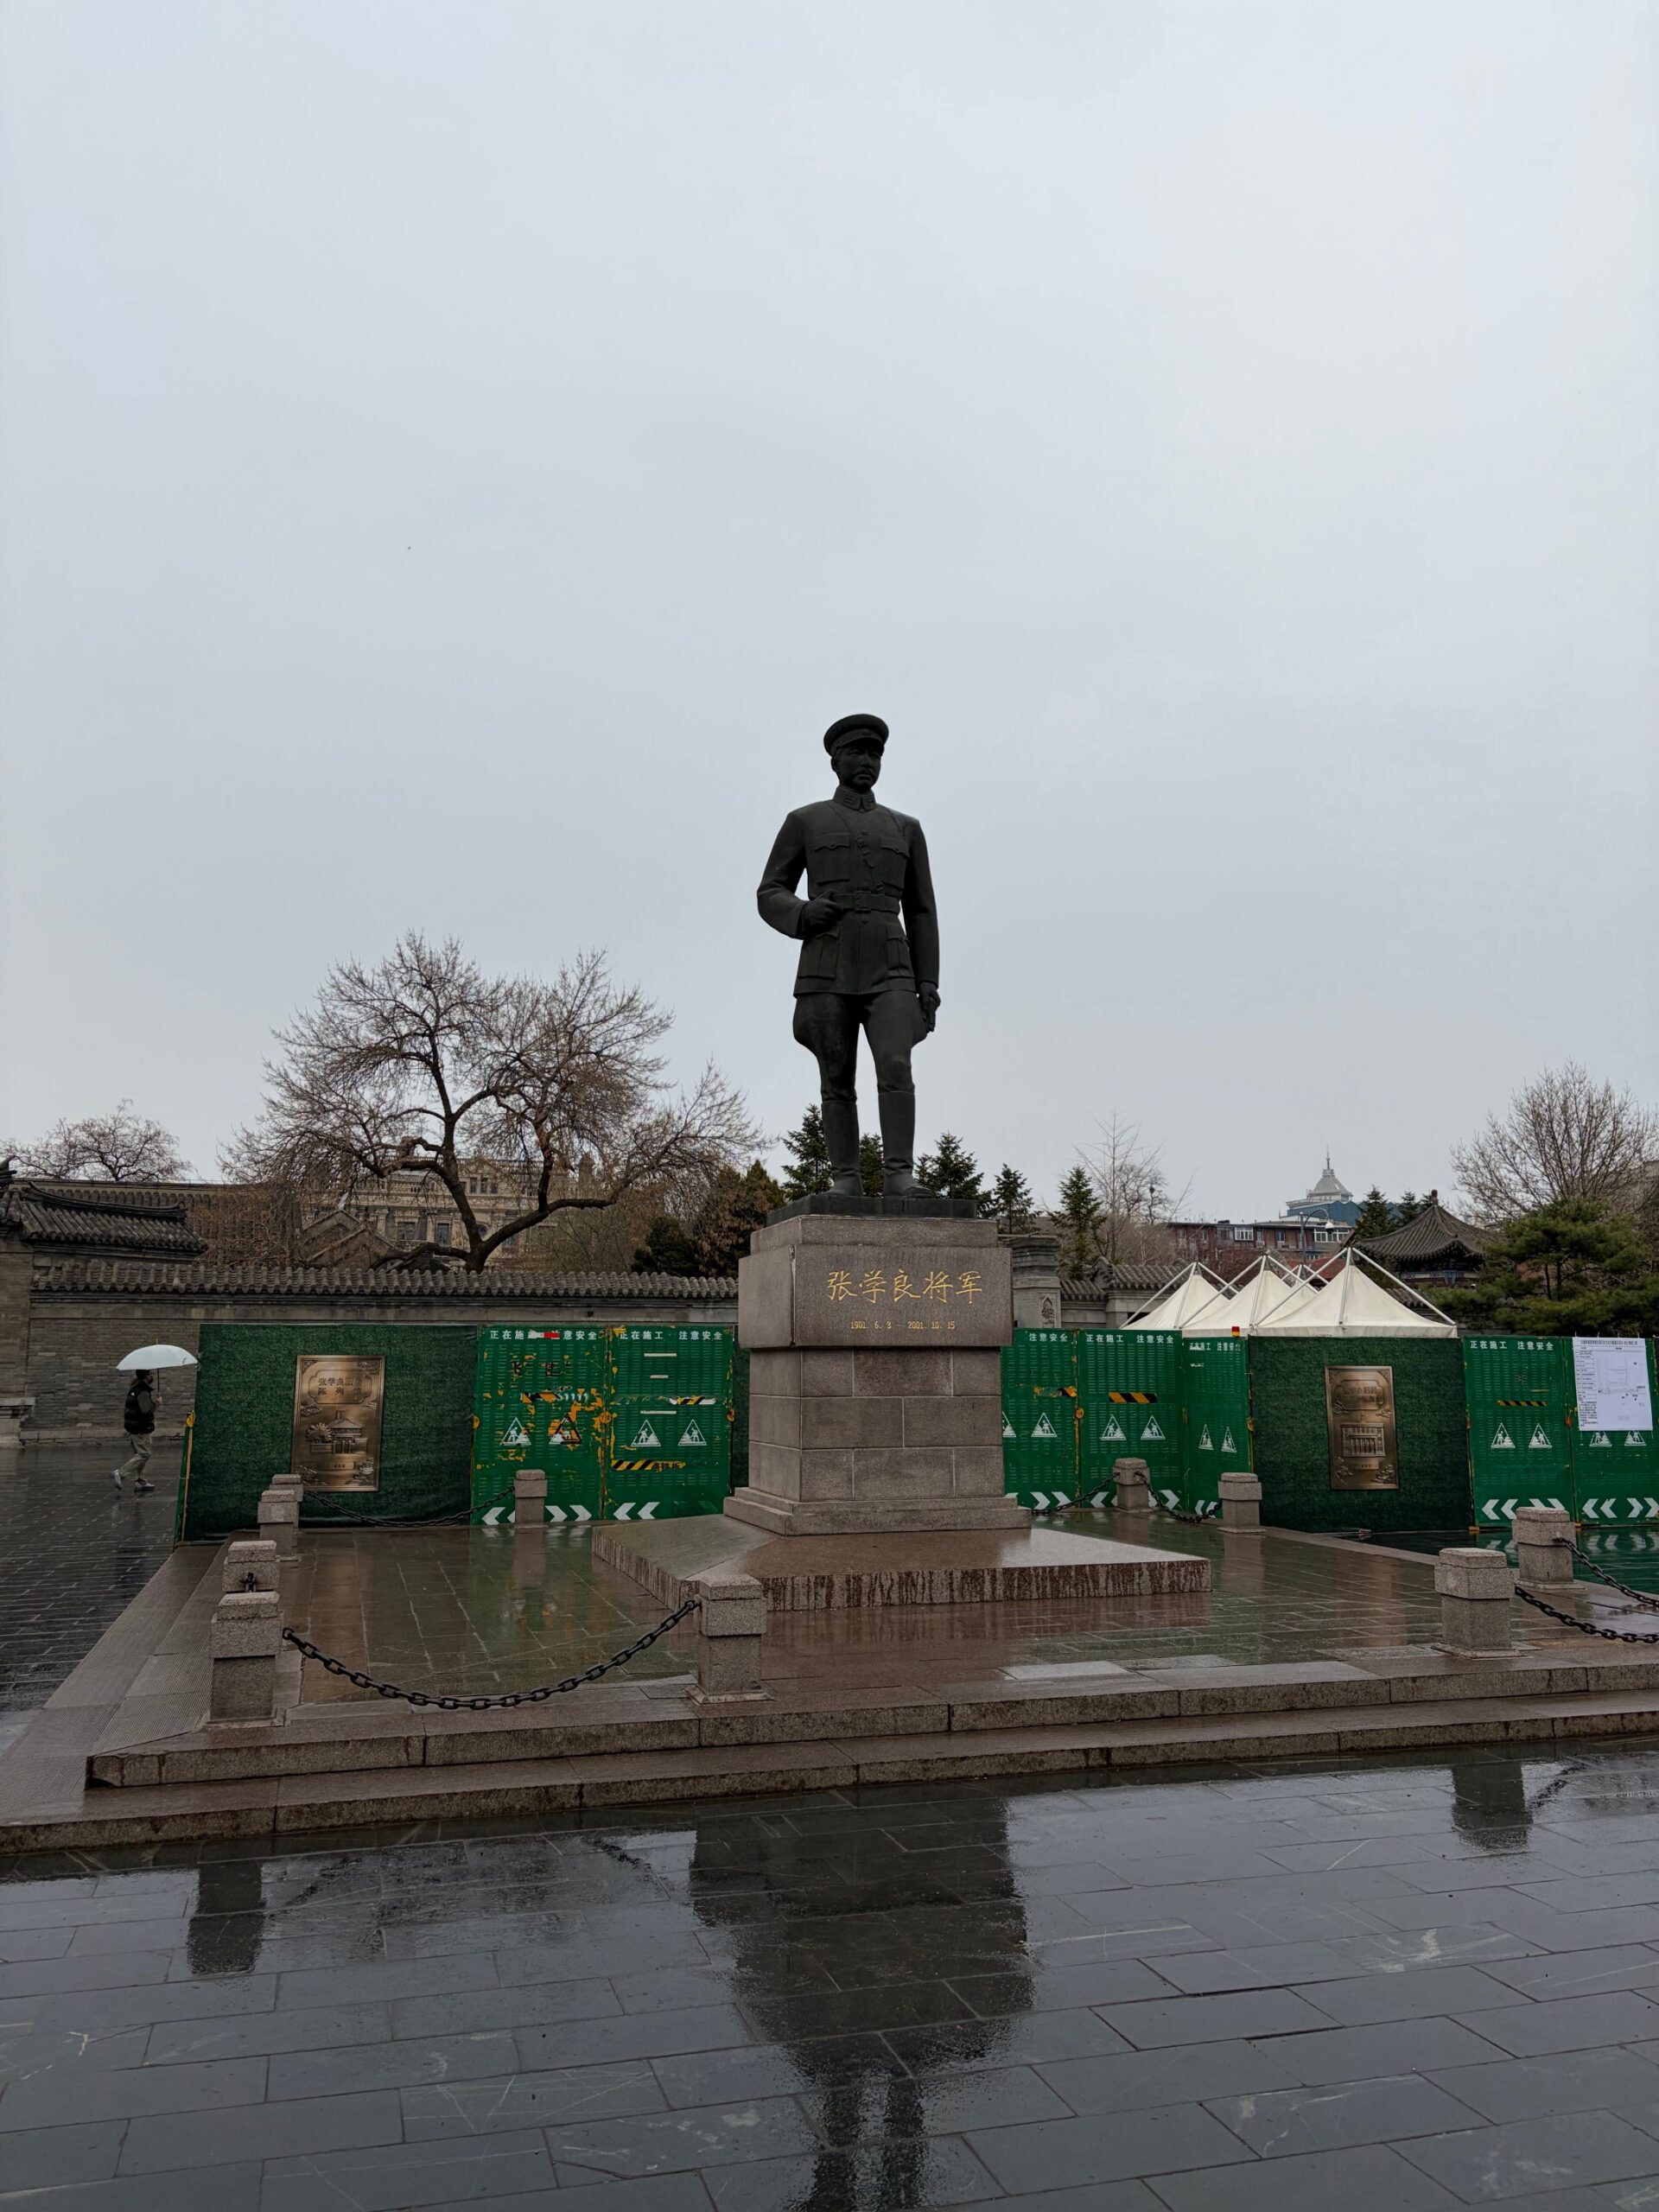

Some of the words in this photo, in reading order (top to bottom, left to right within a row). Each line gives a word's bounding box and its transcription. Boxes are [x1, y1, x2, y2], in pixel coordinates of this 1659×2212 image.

[827, 1268, 982, 1304] 张学良将军
[947, 1320, 956, 1329] 15
[620, 1331, 664, 1340] 正在施工
[678, 1331, 722, 1340] 注意安全
[1028, 1333, 1068, 1342] 注意安全
[1085, 1334, 1124, 1343] 正在施工
[1136, 1334, 1174, 1344] 注意安全
[1470, 1340, 1508, 1350] 正在施工
[1517, 1341, 1554, 1351] 注意安全
